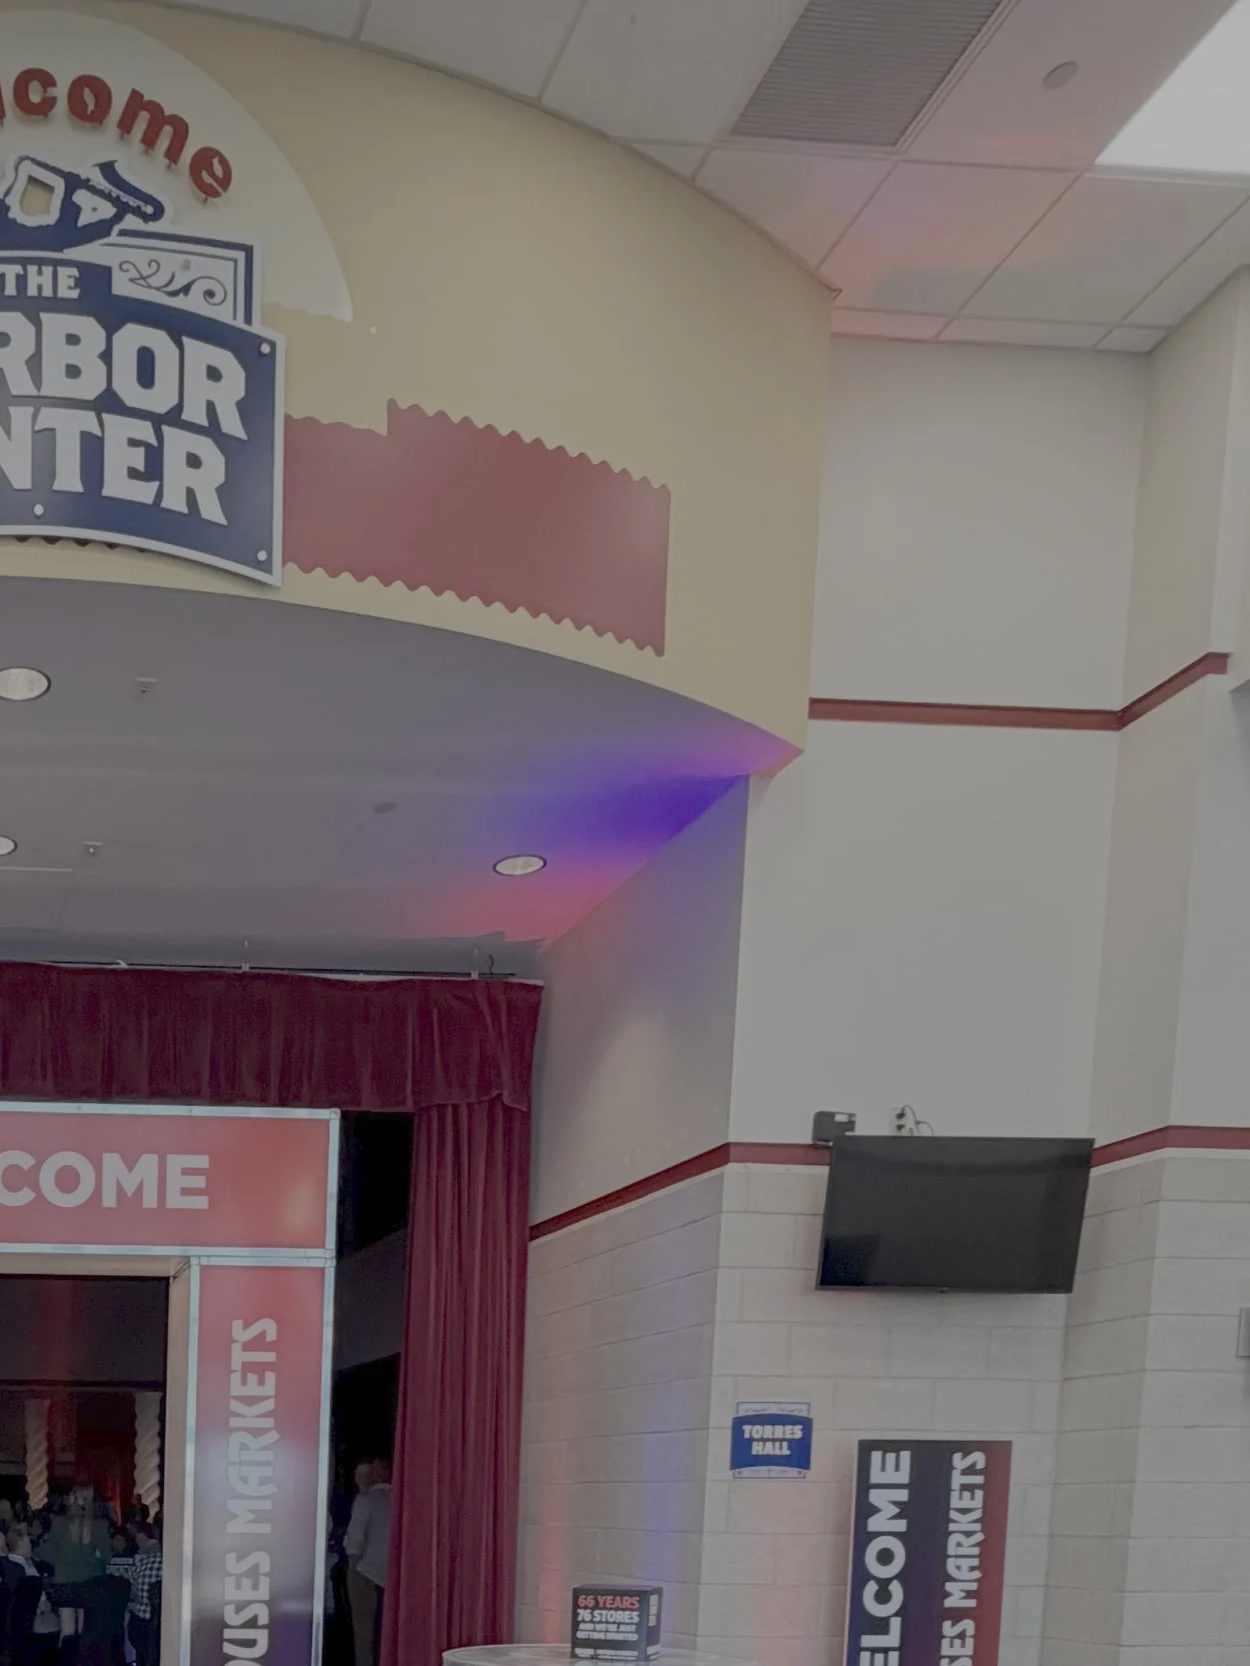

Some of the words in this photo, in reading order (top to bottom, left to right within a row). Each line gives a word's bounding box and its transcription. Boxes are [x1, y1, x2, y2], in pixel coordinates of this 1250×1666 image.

[228, 1317, 281, 1534] MARKETS
[742, 1425, 803, 1439] TORRES
[752, 1441, 791, 1456] HALL
[943, 1451, 986, 1607] MARKETS
[597, 1595, 640, 1609] YEARS
[576, 1609, 592, 1622] 76
[592, 1610, 640, 1623] STORES
